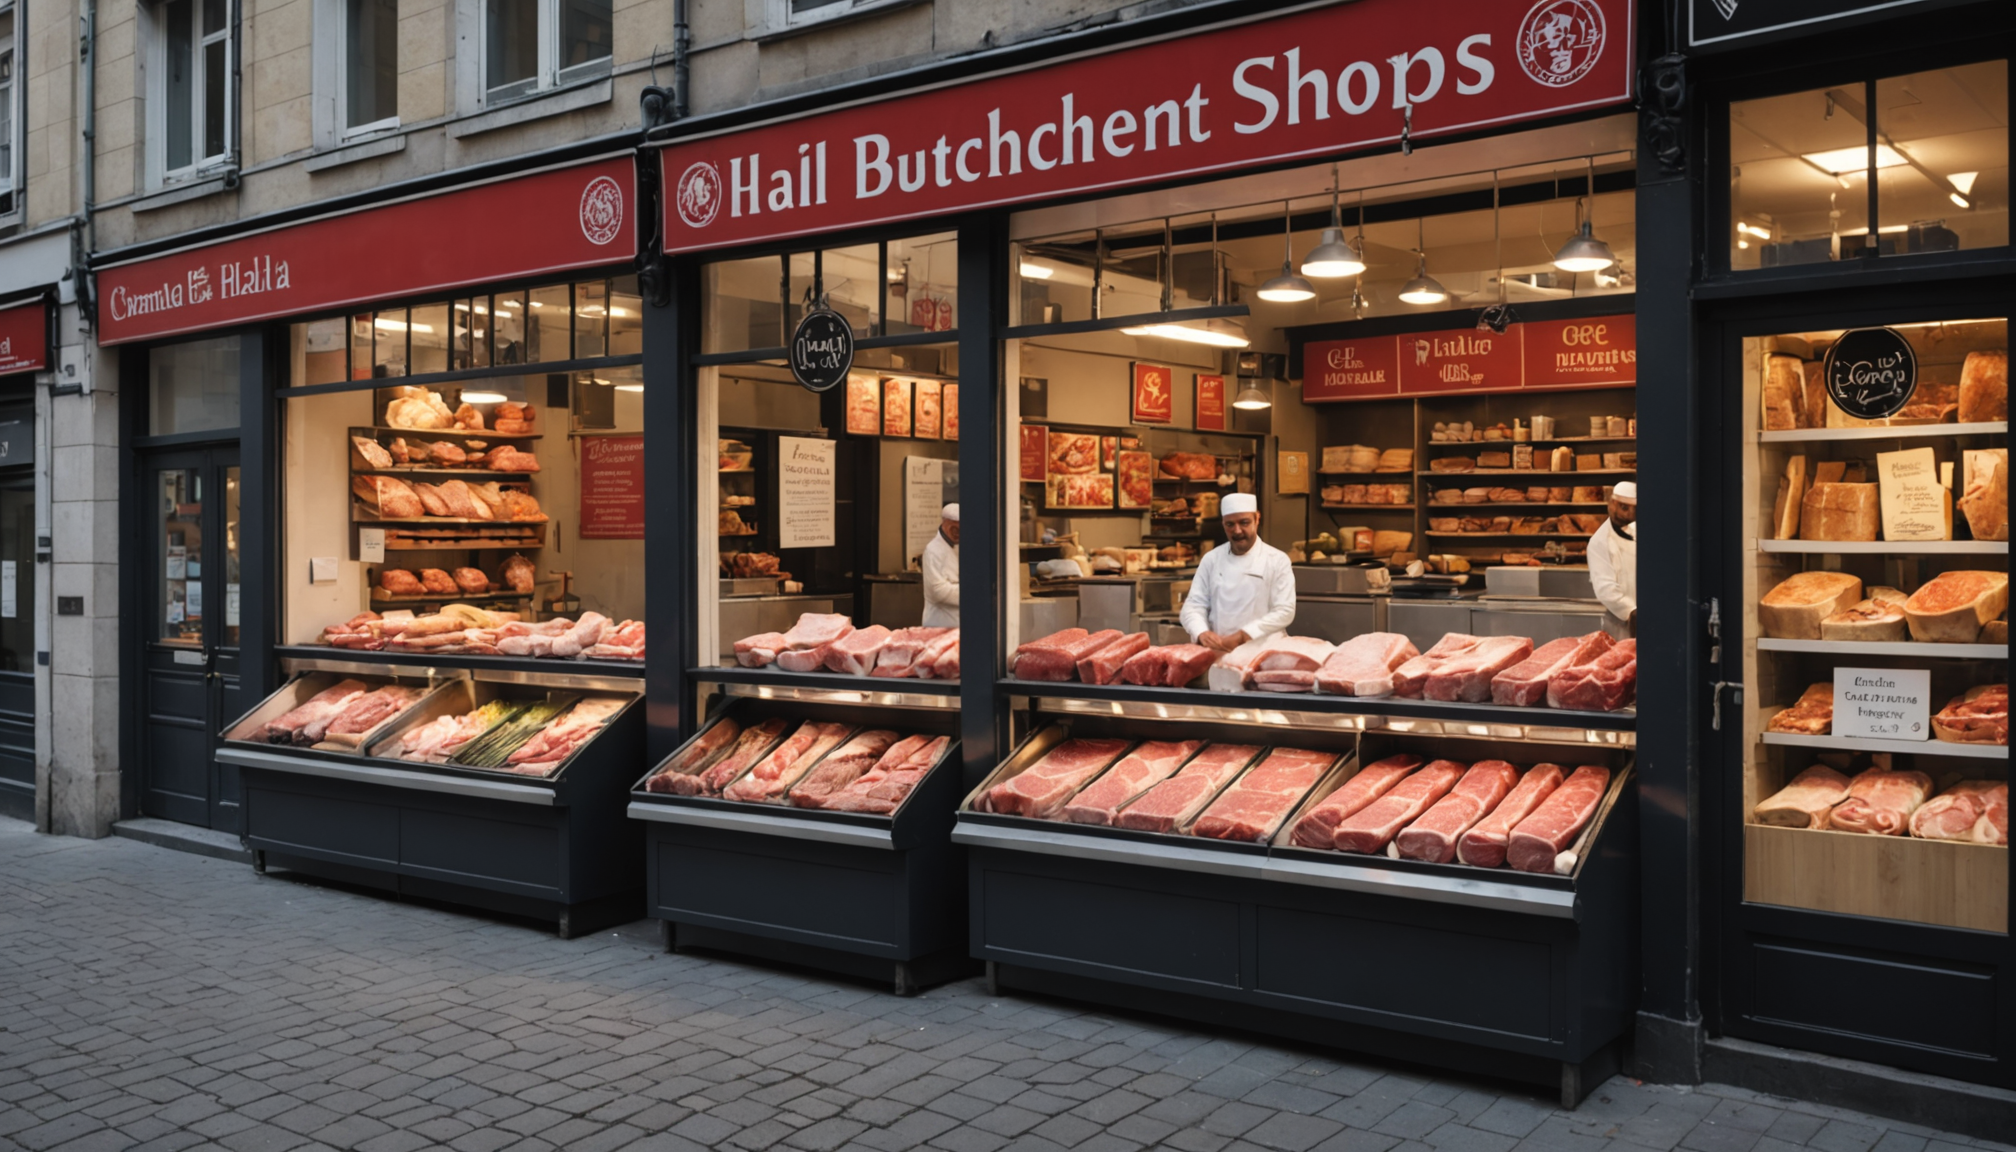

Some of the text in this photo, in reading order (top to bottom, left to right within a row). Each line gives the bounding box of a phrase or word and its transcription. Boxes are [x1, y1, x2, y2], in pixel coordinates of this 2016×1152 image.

[729, 32, 1496, 218] Hail Butchchent Shops
